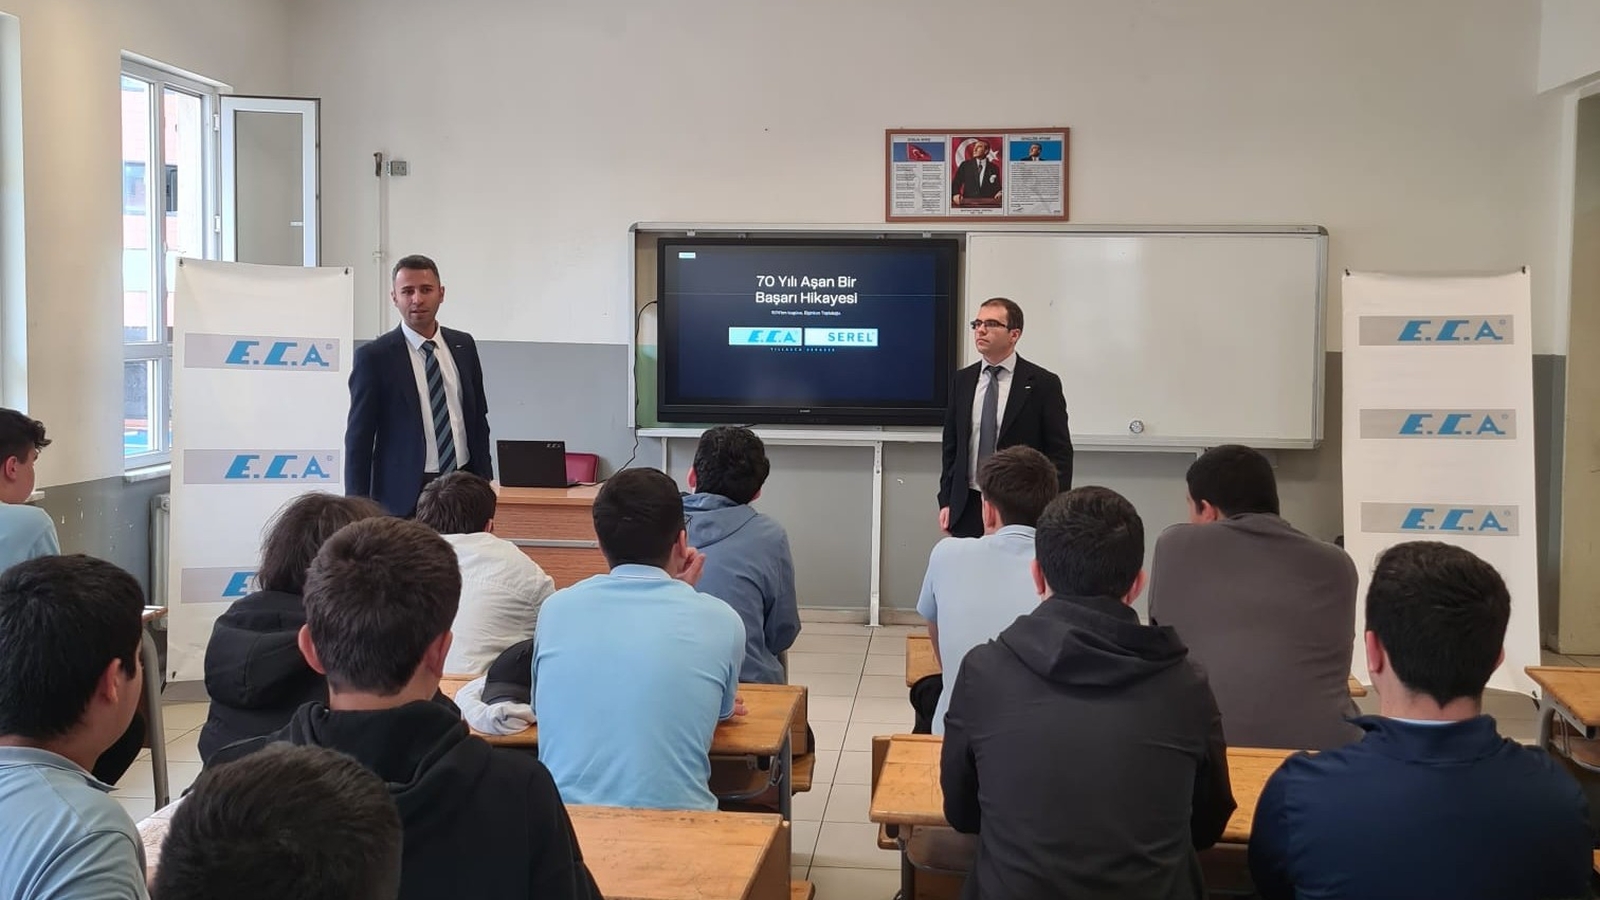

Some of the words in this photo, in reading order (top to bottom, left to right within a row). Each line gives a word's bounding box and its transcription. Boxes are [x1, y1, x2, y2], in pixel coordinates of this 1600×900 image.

[756, 275, 775, 288] 70
[778, 275, 797, 288] Yılı
[800, 275, 835, 290] Aşan
[837, 275, 857, 288] Bir
[755, 291, 798, 306] Başarı
[800, 291, 858, 307] Hikayesi
[828, 331, 873, 343] SEREL
